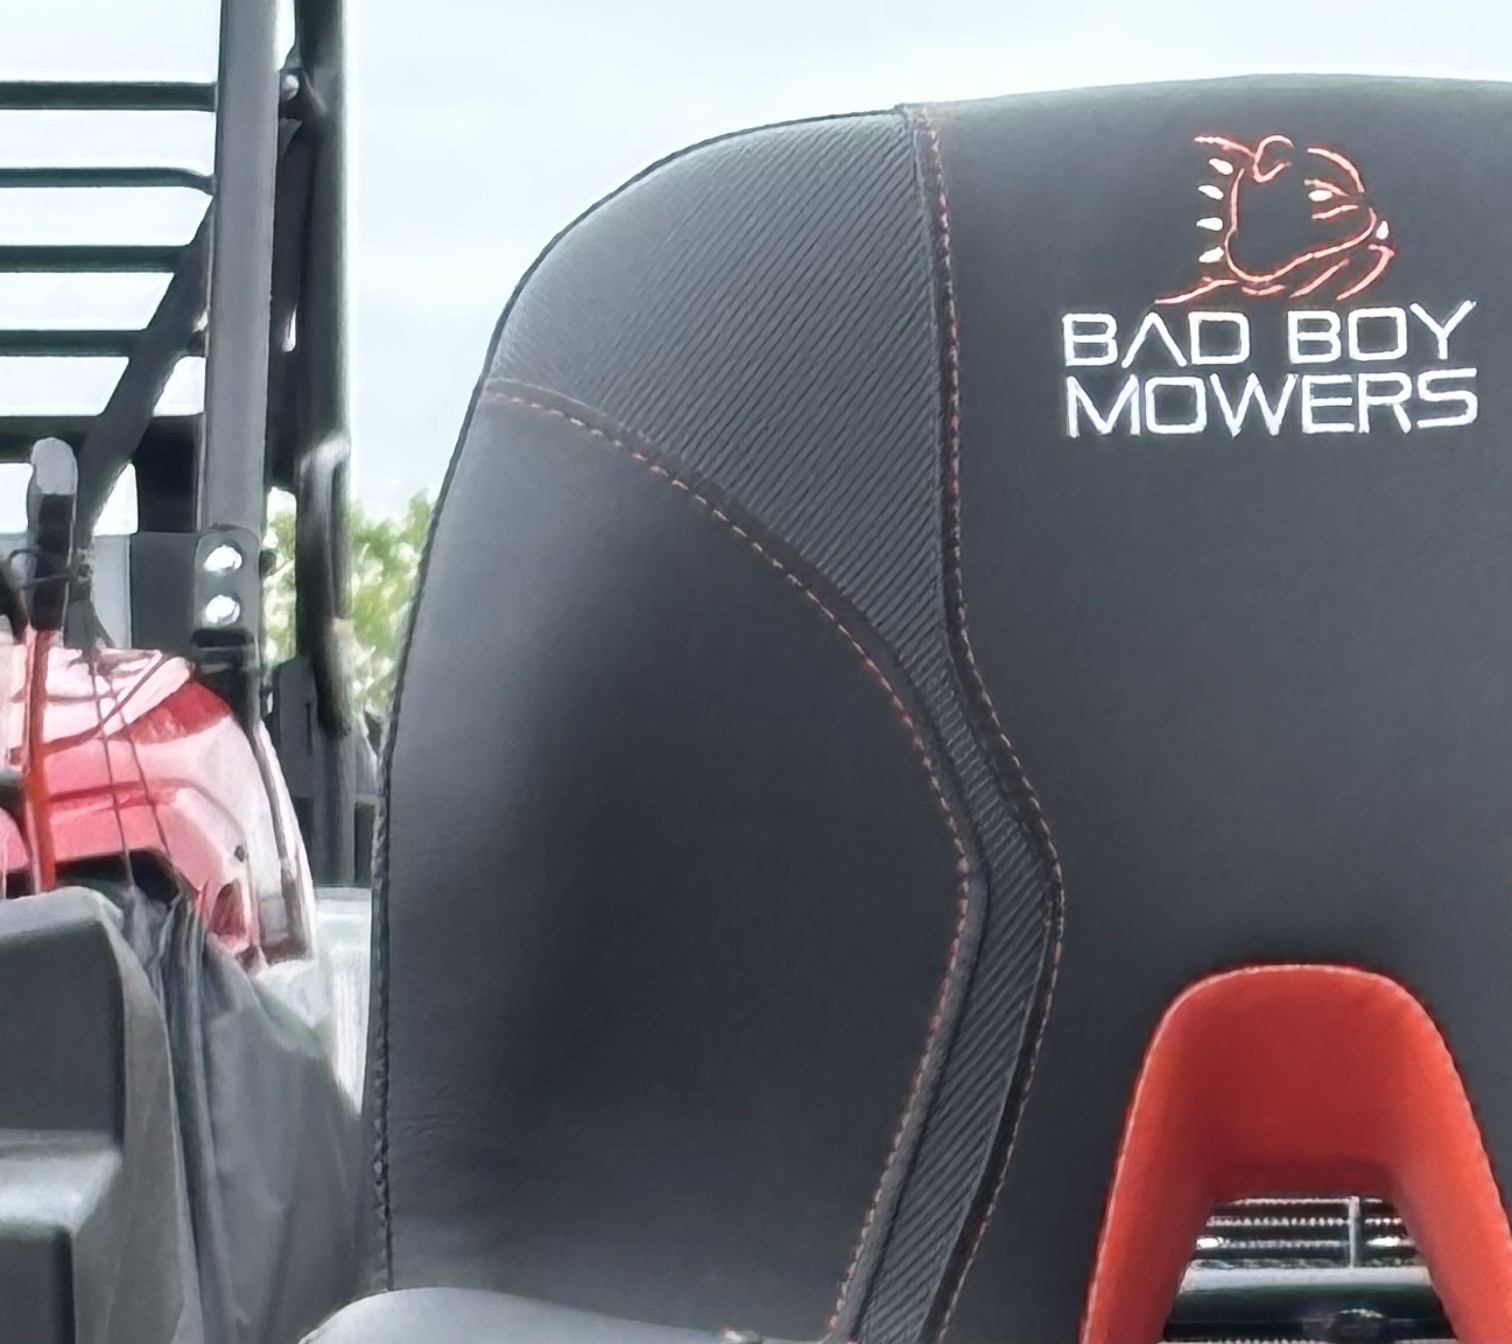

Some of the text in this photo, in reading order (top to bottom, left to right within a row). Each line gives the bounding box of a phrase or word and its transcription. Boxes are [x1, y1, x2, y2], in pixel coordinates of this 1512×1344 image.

[1061, 300, 1477, 369] BAD BOY
[1065, 367, 1478, 438] MOWERS
